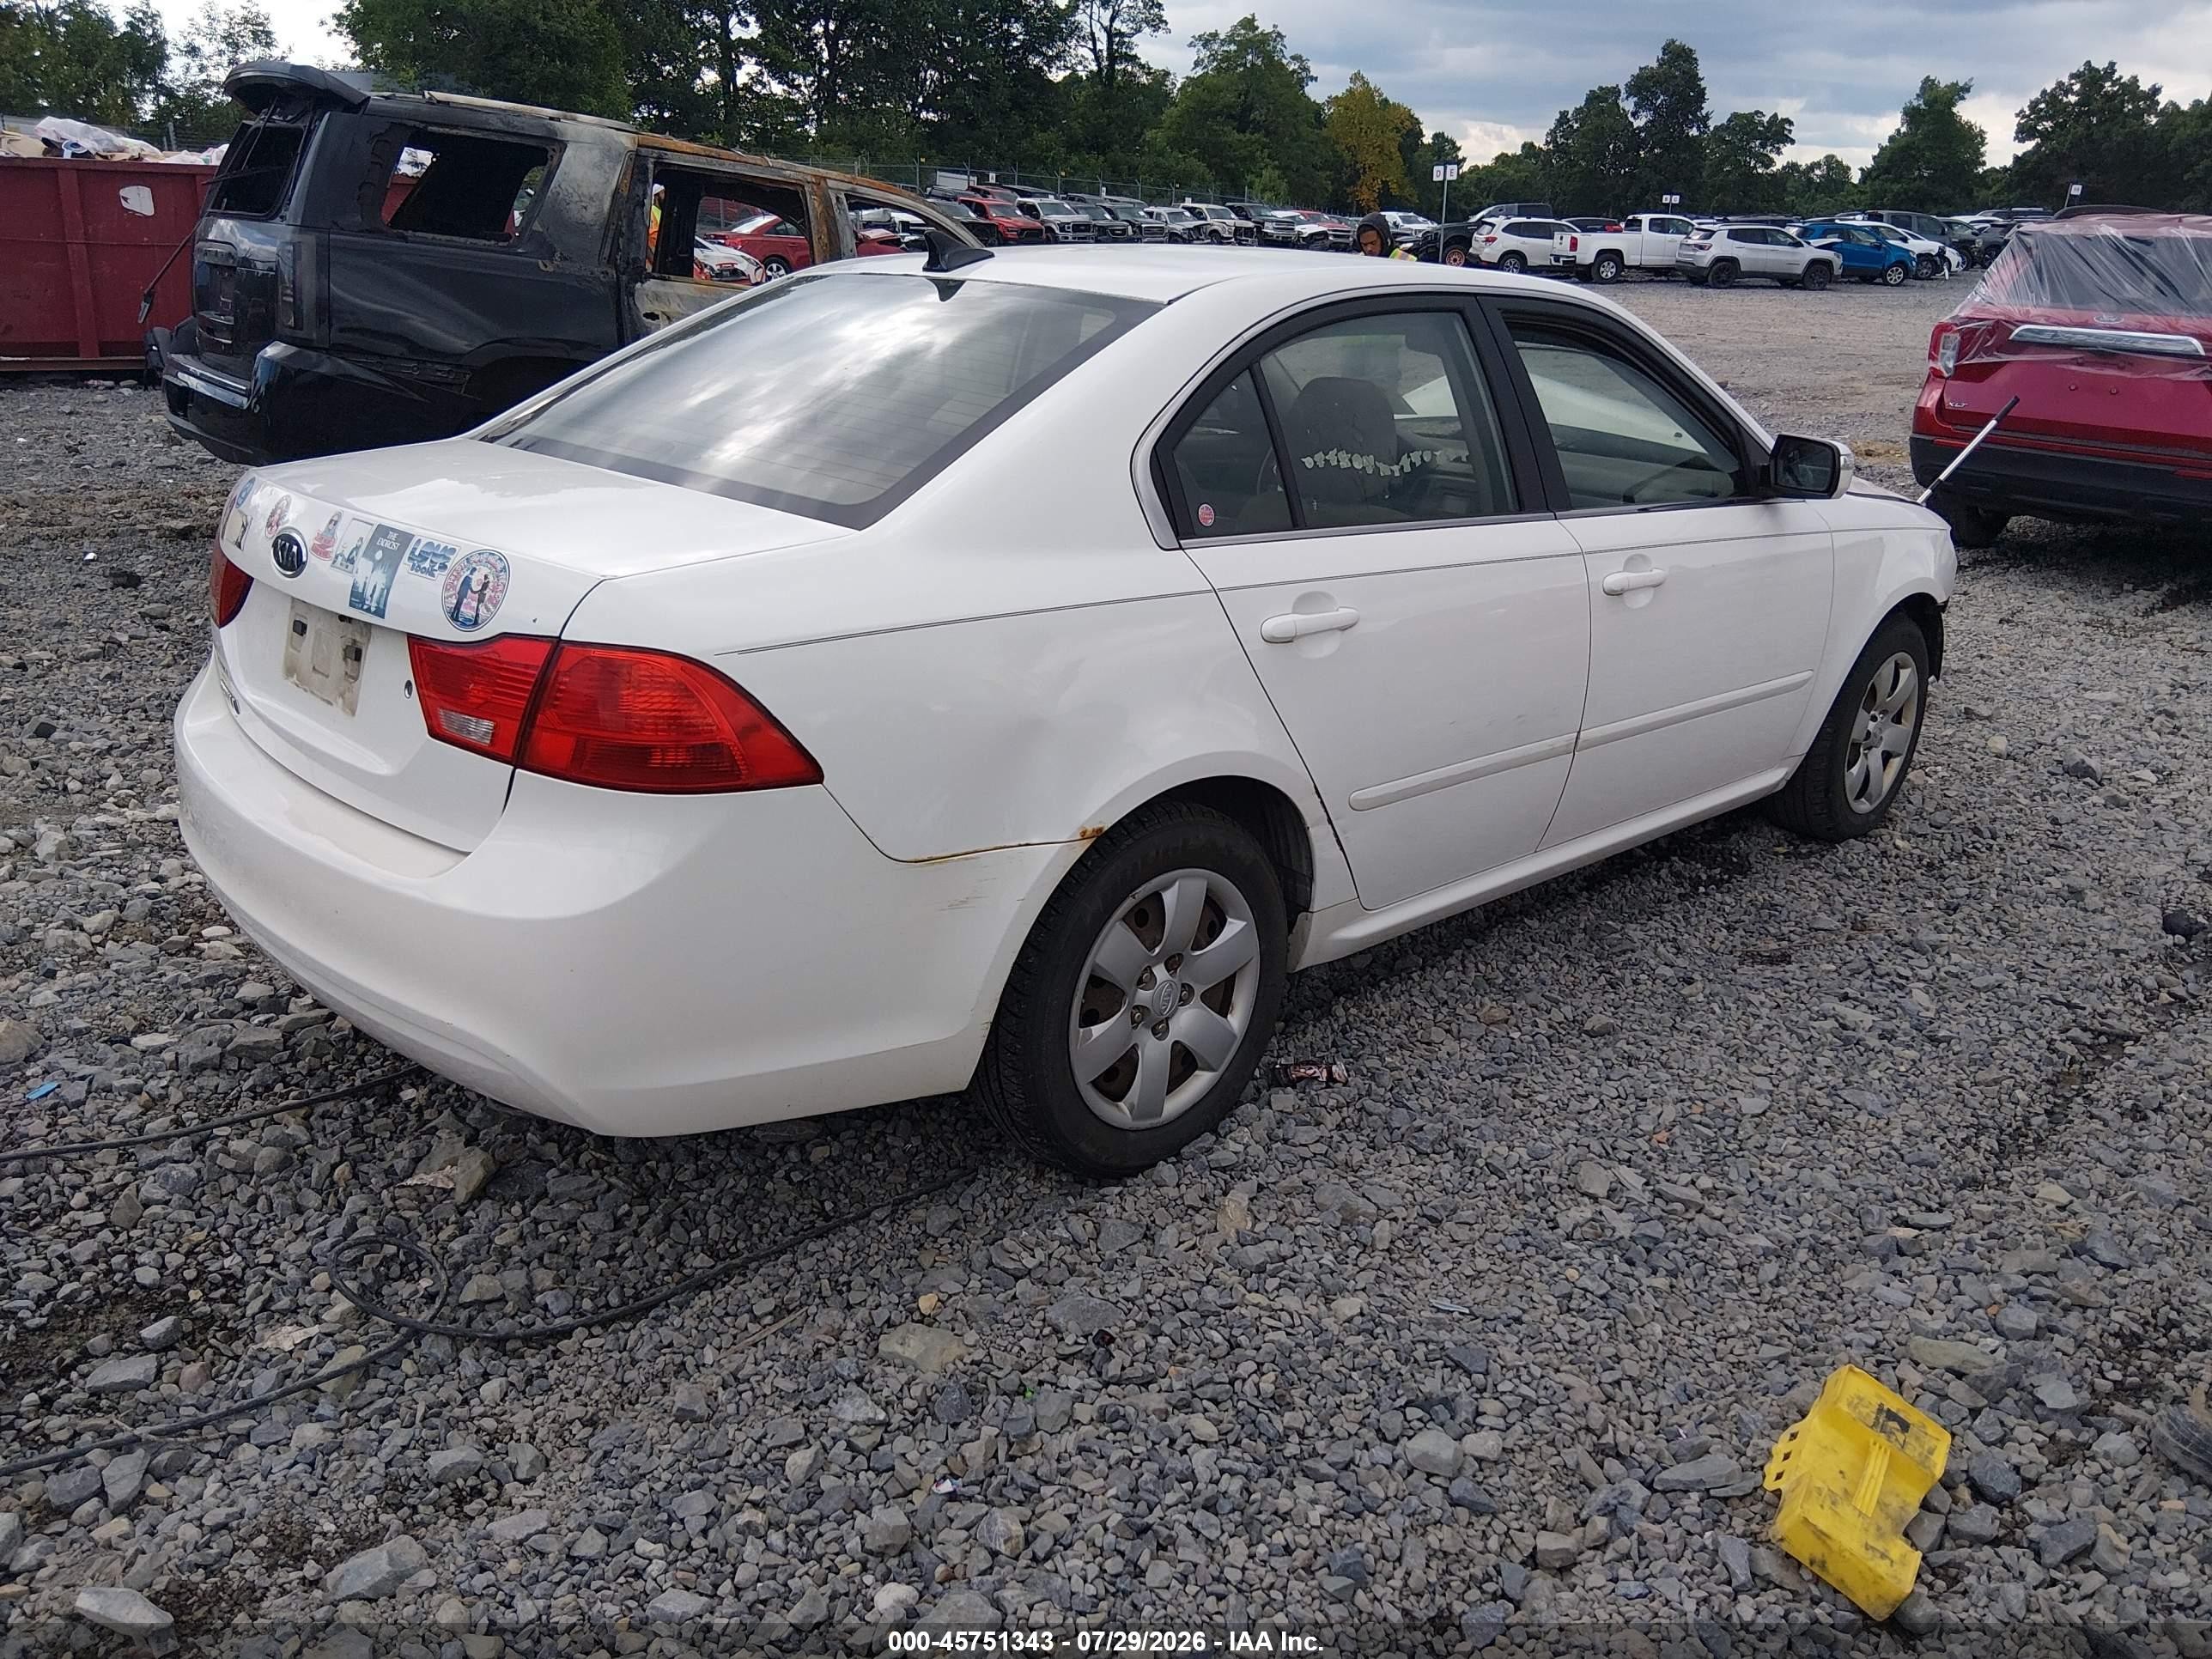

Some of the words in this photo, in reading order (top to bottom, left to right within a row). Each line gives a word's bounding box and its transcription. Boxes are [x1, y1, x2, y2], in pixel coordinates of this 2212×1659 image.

[386, 531, 398, 541] THE
[376, 537, 401, 550] EXORCIST
[277, 538, 298, 569] KIA
